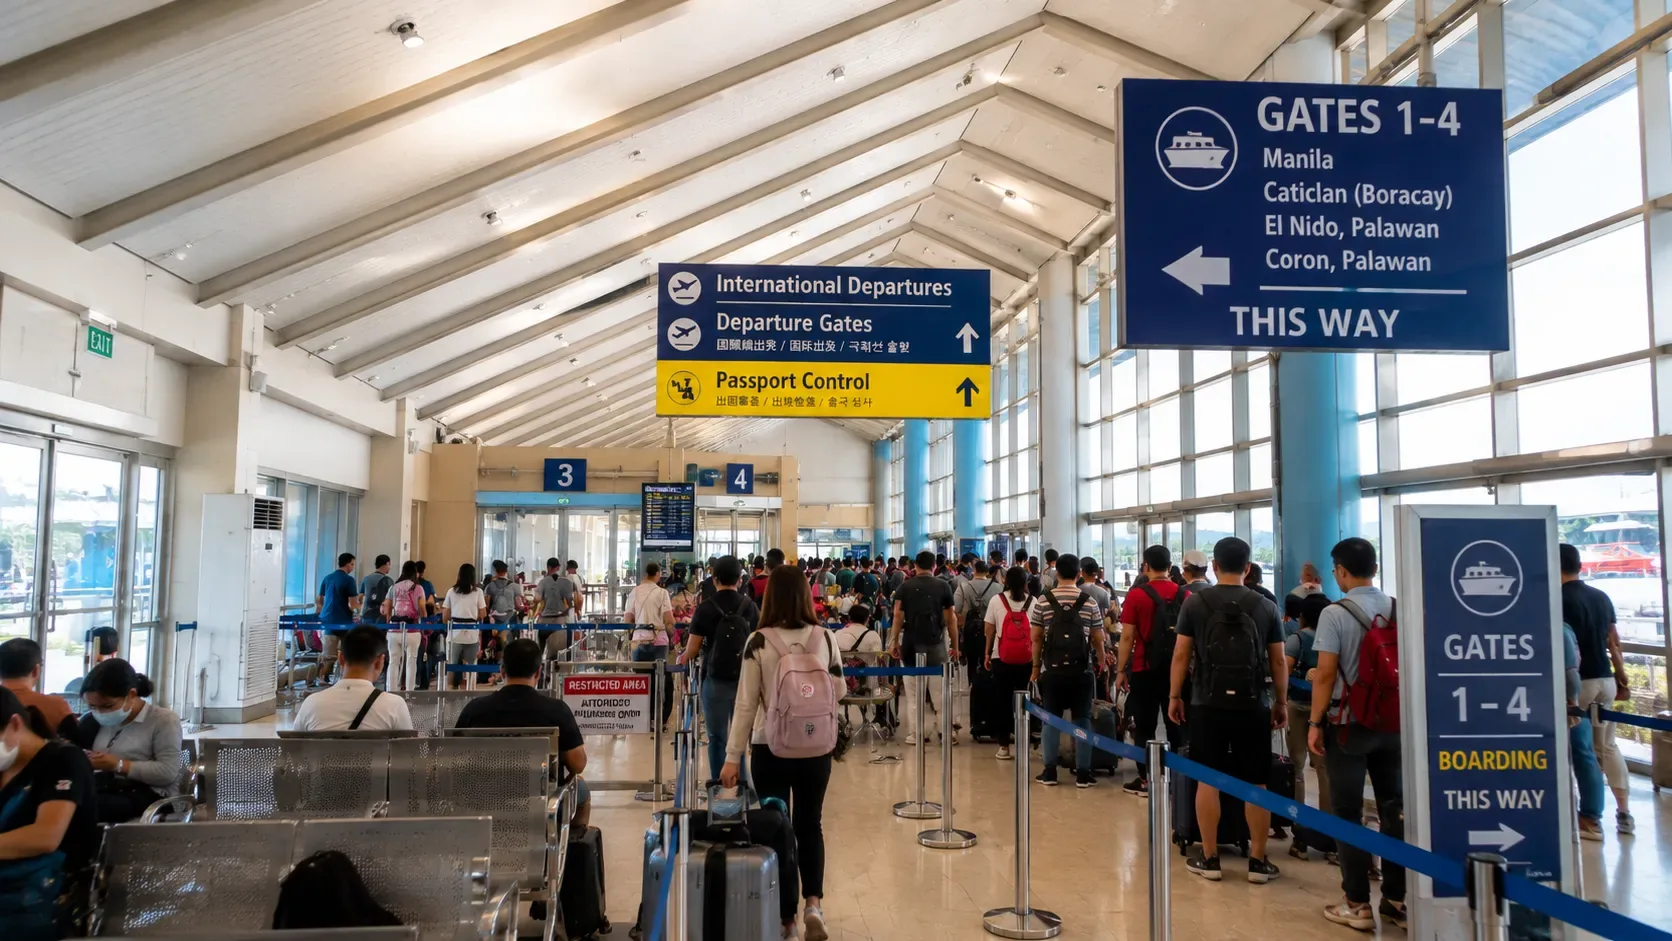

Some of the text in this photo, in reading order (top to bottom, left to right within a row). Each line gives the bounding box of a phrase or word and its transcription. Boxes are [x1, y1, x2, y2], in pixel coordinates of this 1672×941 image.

[1258, 96, 1381, 134] GATES
[1263, 148, 1334, 170] Manila
[1264, 181, 1453, 211] Caticlan (Boracay)
[1265, 215, 1439, 240] El Nido, Palawan
[1265, 249, 1432, 274] Coron, Palawan
[716, 274, 953, 300] International Departures
[717, 312, 873, 336] Departure Gates
[1230, 306, 1400, 338] THIS WAY
[716, 371, 870, 393] Passport Control
[557, 463, 574, 487] 3
[734, 468, 748, 490] 4
[1444, 634, 1535, 661] GATES
[1439, 750, 1547, 770] BOARDING
[1444, 789, 1545, 810] THIS WAY
